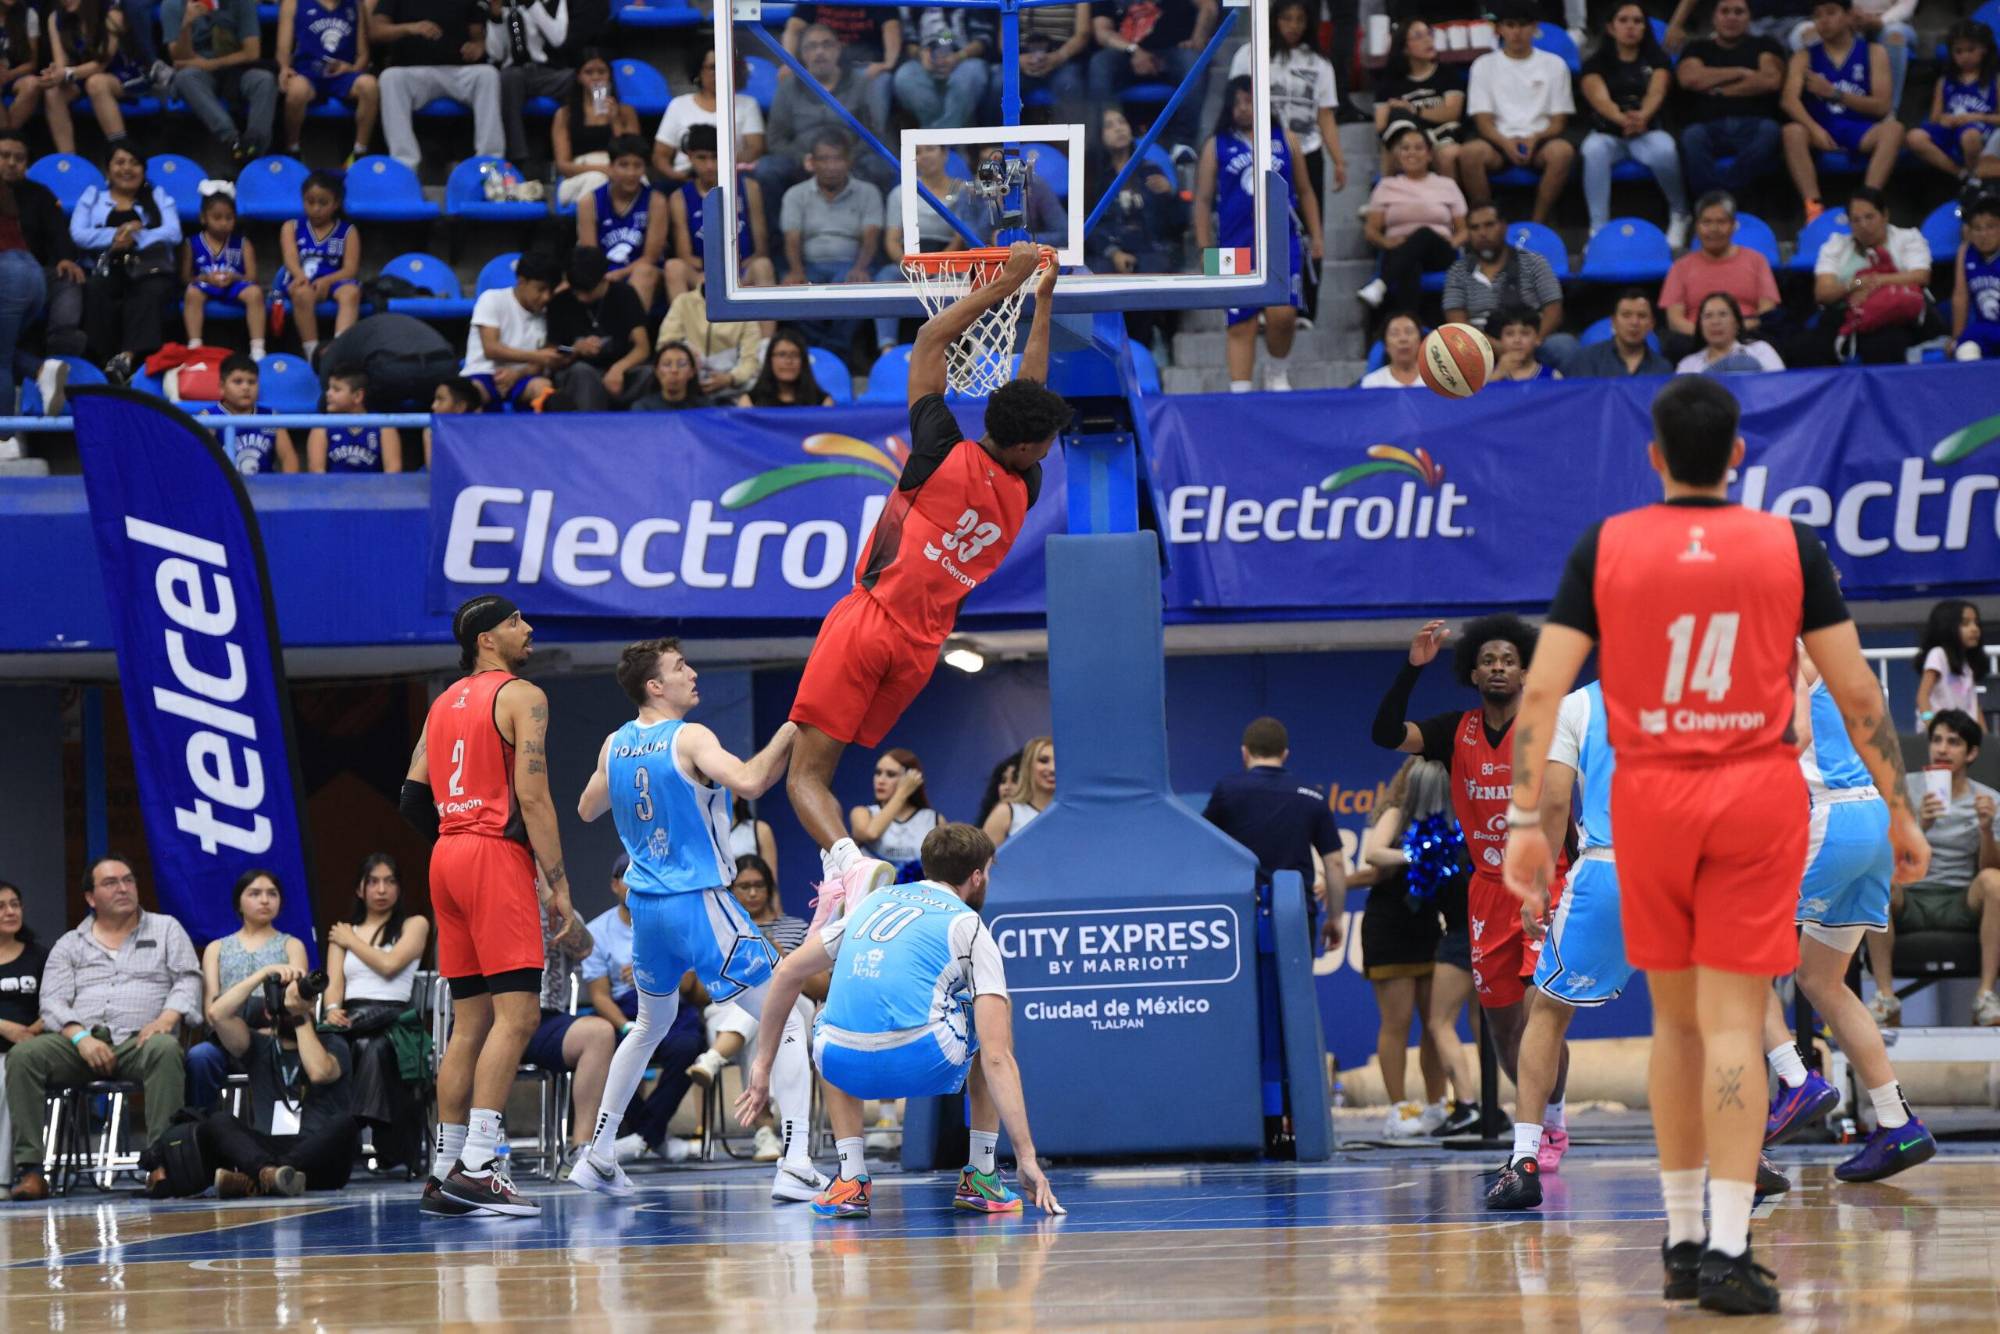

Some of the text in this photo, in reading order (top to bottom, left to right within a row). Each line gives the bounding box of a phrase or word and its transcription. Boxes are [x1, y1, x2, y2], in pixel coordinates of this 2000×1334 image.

[1168, 482, 1468, 543] Electrolit
[1728, 456, 2000, 557] lectr
[443, 485, 889, 590] Electrol
[941, 508, 1002, 563] 33
[941, 556, 977, 589] Chevron
[1662, 611, 1741, 705] 14
[125, 515, 273, 855] telcel
[1673, 708, 1766, 730] Chevron
[448, 739, 465, 797] 2
[614, 740, 669, 759] YOAKUM
[634, 765, 654, 821] 3
[1473, 830, 1501, 842] Banco
[852, 901, 925, 943] 10
[998, 919, 1231, 958] CITY EXPRESS
[1048, 955, 1188, 975] BY MARRIOTT
[1024, 995, 1210, 1020] Ciudad de México
[1091, 1018, 1144, 1031] TLALPAN
